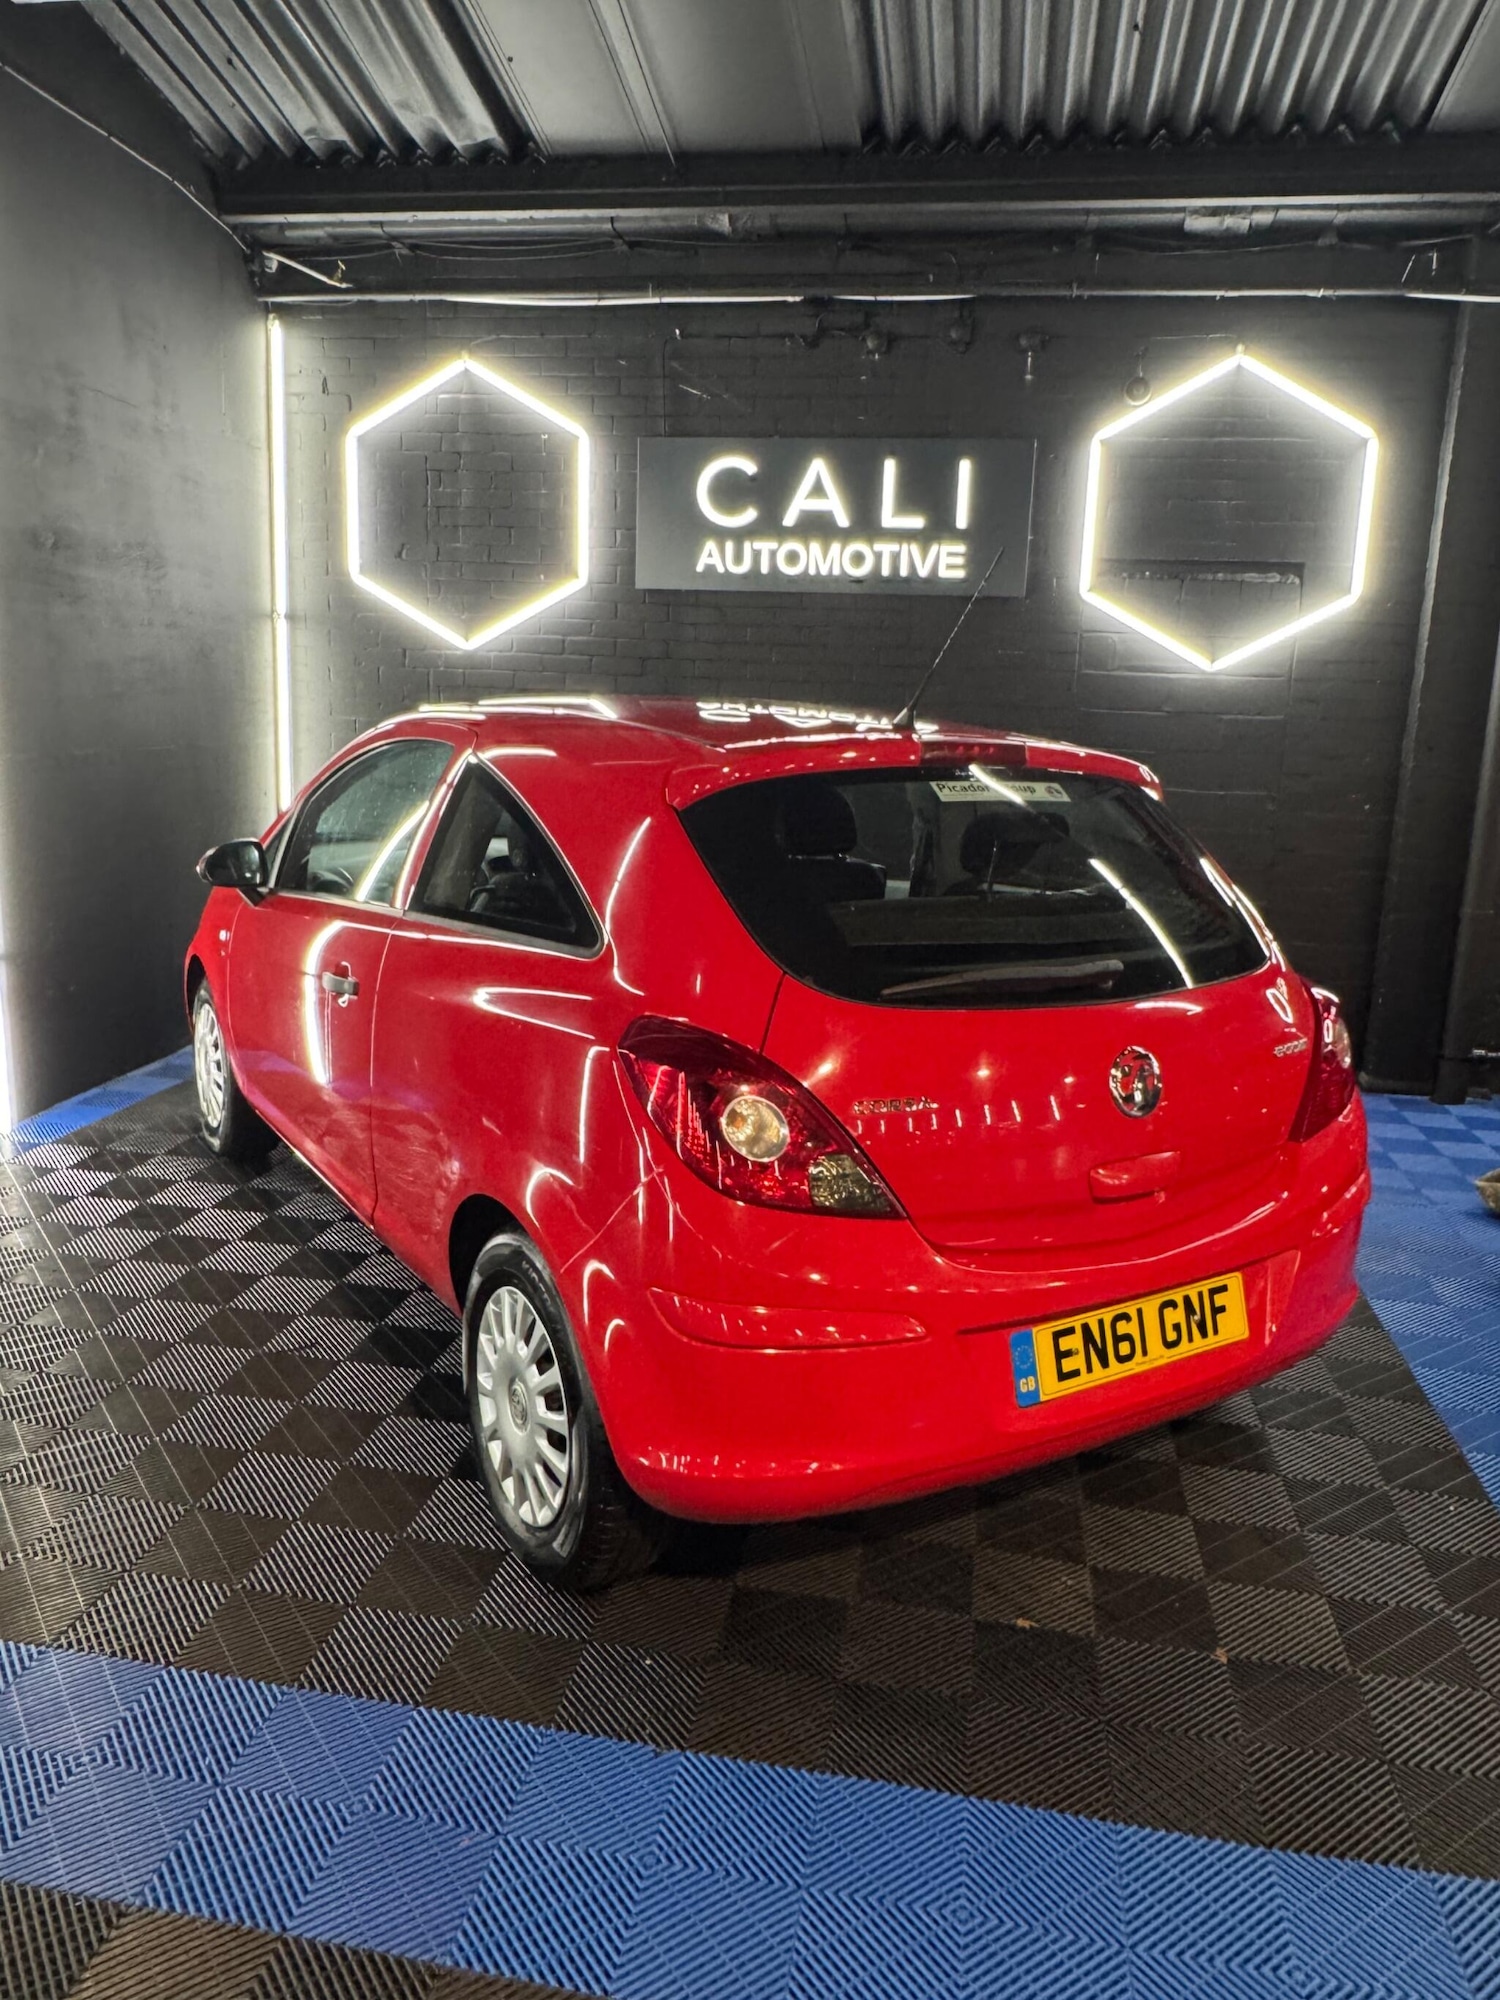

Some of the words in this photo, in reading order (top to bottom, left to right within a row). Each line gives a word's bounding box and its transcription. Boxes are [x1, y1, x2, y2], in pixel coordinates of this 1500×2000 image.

[696, 456, 972, 530] CALI
[696, 541, 967, 579] AUTOMOTIVE
[936, 781, 990, 793] Picador
[1052, 1307, 1148, 1382] EN61
[1158, 1284, 1228, 1350] GNF
[1020, 1376, 1036, 1393] GB
